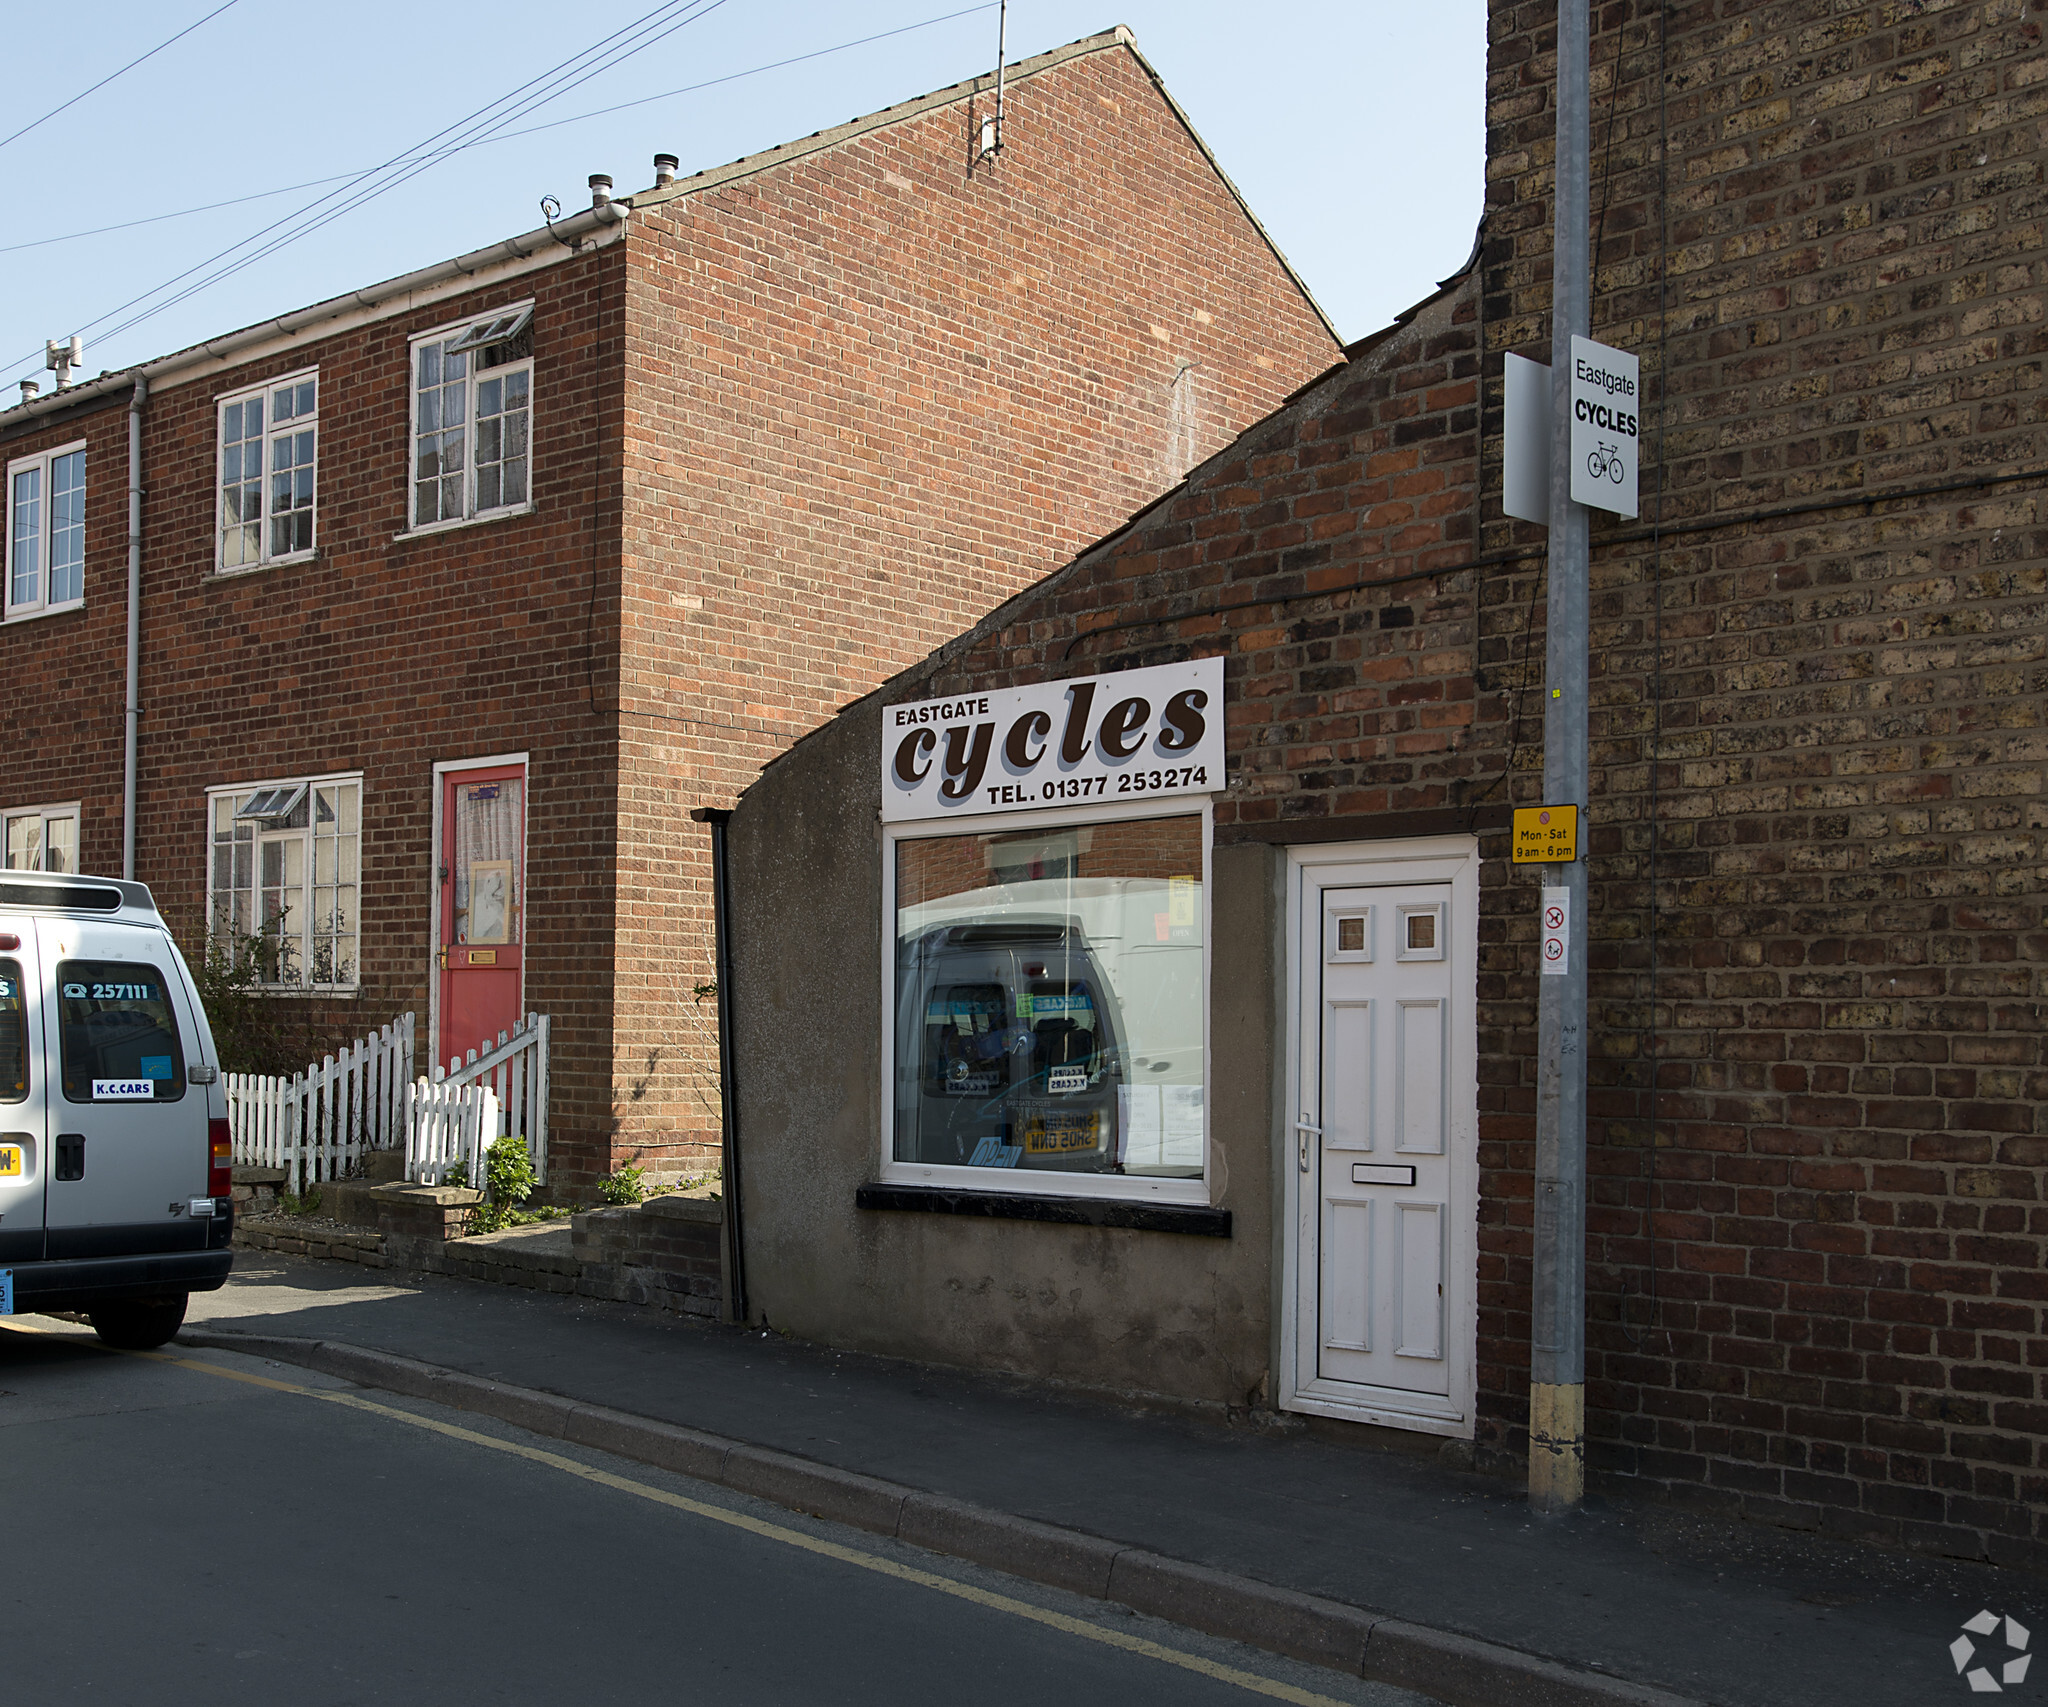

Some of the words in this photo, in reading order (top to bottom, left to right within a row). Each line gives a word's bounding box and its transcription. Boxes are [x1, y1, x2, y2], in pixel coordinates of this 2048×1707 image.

[1576, 358, 1635, 397] Eastgate
[1575, 398, 1637, 438] CYCLES
[895, 698, 989, 727] EASTGATE
[891, 682, 1209, 808] cycles
[987, 784, 1035, 805] TEL.
[1042, 777, 1108, 800] 01377
[1117, 766, 1208, 793] 253274
[1520, 830, 1542, 841] Mon
[1549, 828, 1567, 839] Sat
[1516, 847, 1523, 858] 9
[1547, 845, 1554, 856] 6
[1556, 848, 1571, 857] pm
[92, 984, 148, 999] 257111
[96, 1082, 151, 1096] K.C.CARS
